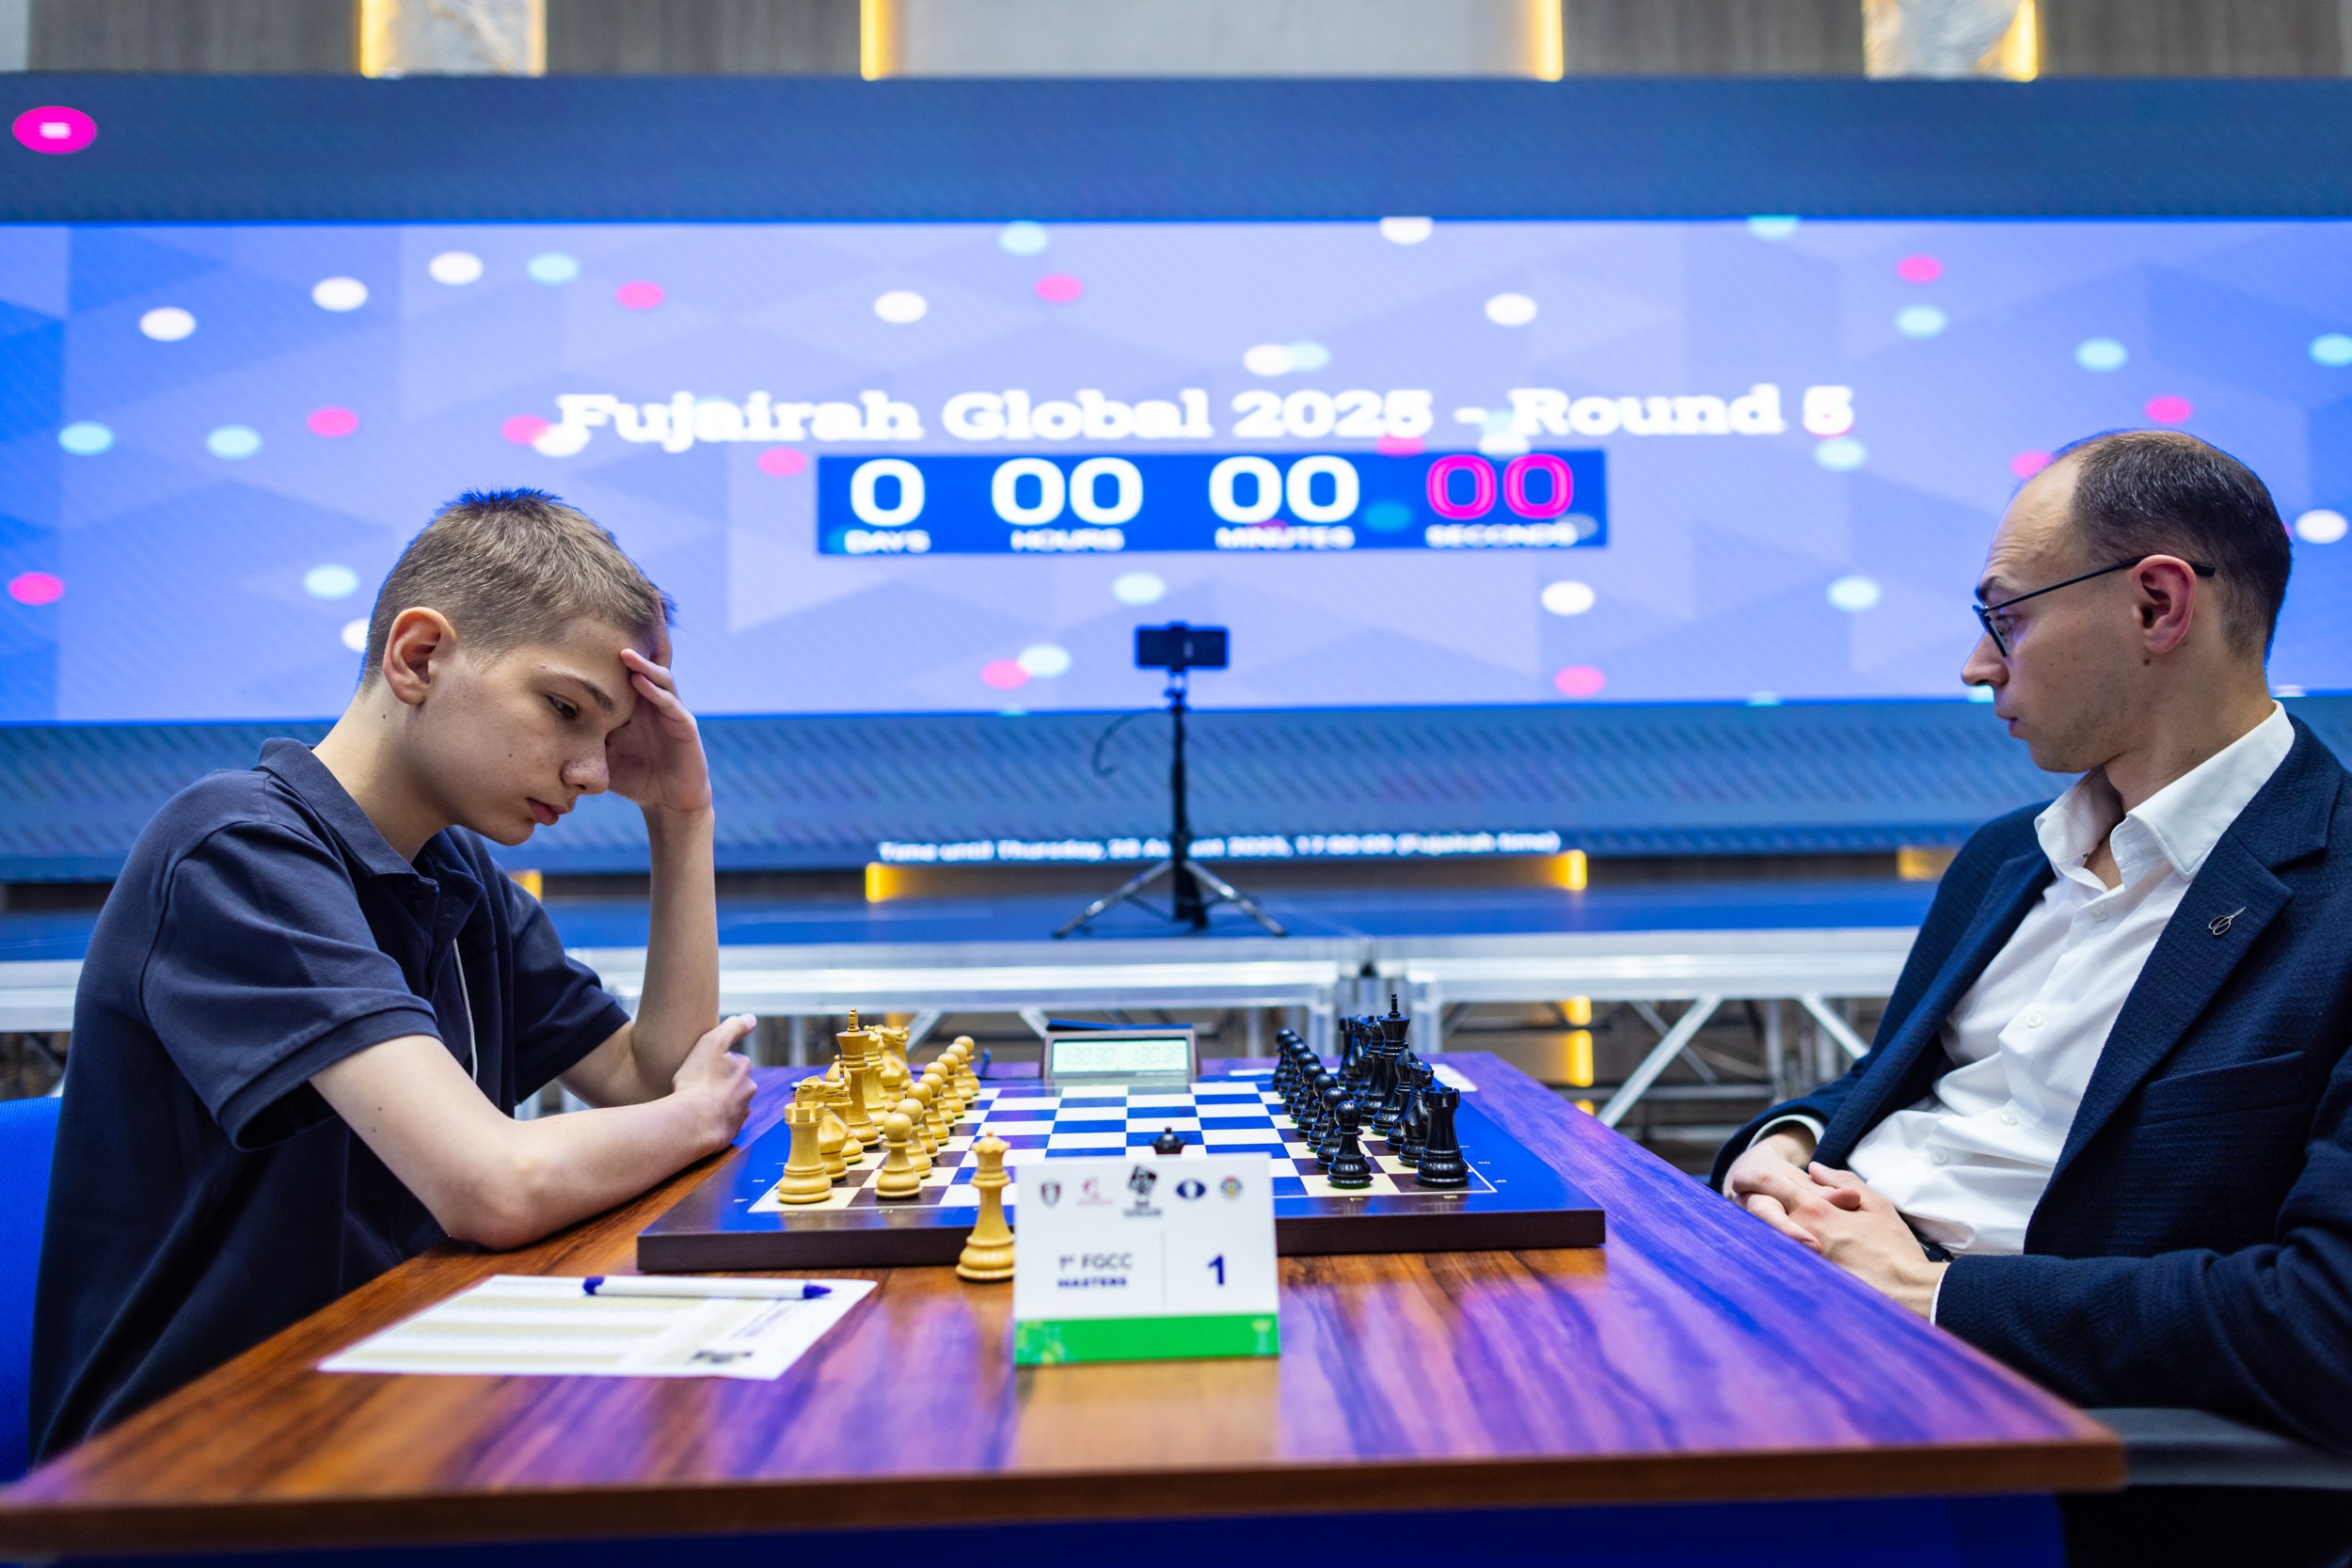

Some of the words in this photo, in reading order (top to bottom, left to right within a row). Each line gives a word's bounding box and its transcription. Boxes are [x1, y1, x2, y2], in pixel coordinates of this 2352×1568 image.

[557, 388, 925, 453] Fujairah
[941, 388, 1214, 441] Global
[1231, 388, 1434, 438] 2025
[1506, 382, 1788, 436] Round
[850, 457, 926, 527] 0
[991, 456, 1144, 526] 00
[1208, 454, 1360, 524] 00
[1425, 452, 1574, 520] 00
[844, 529, 931, 554] DAYS
[1009, 528, 1125, 553] HOURS
[1215, 525, 1356, 550] MINUTES
[1424, 523, 1579, 548] SECONDS
[1208, 1254, 1225, 1286] 1
